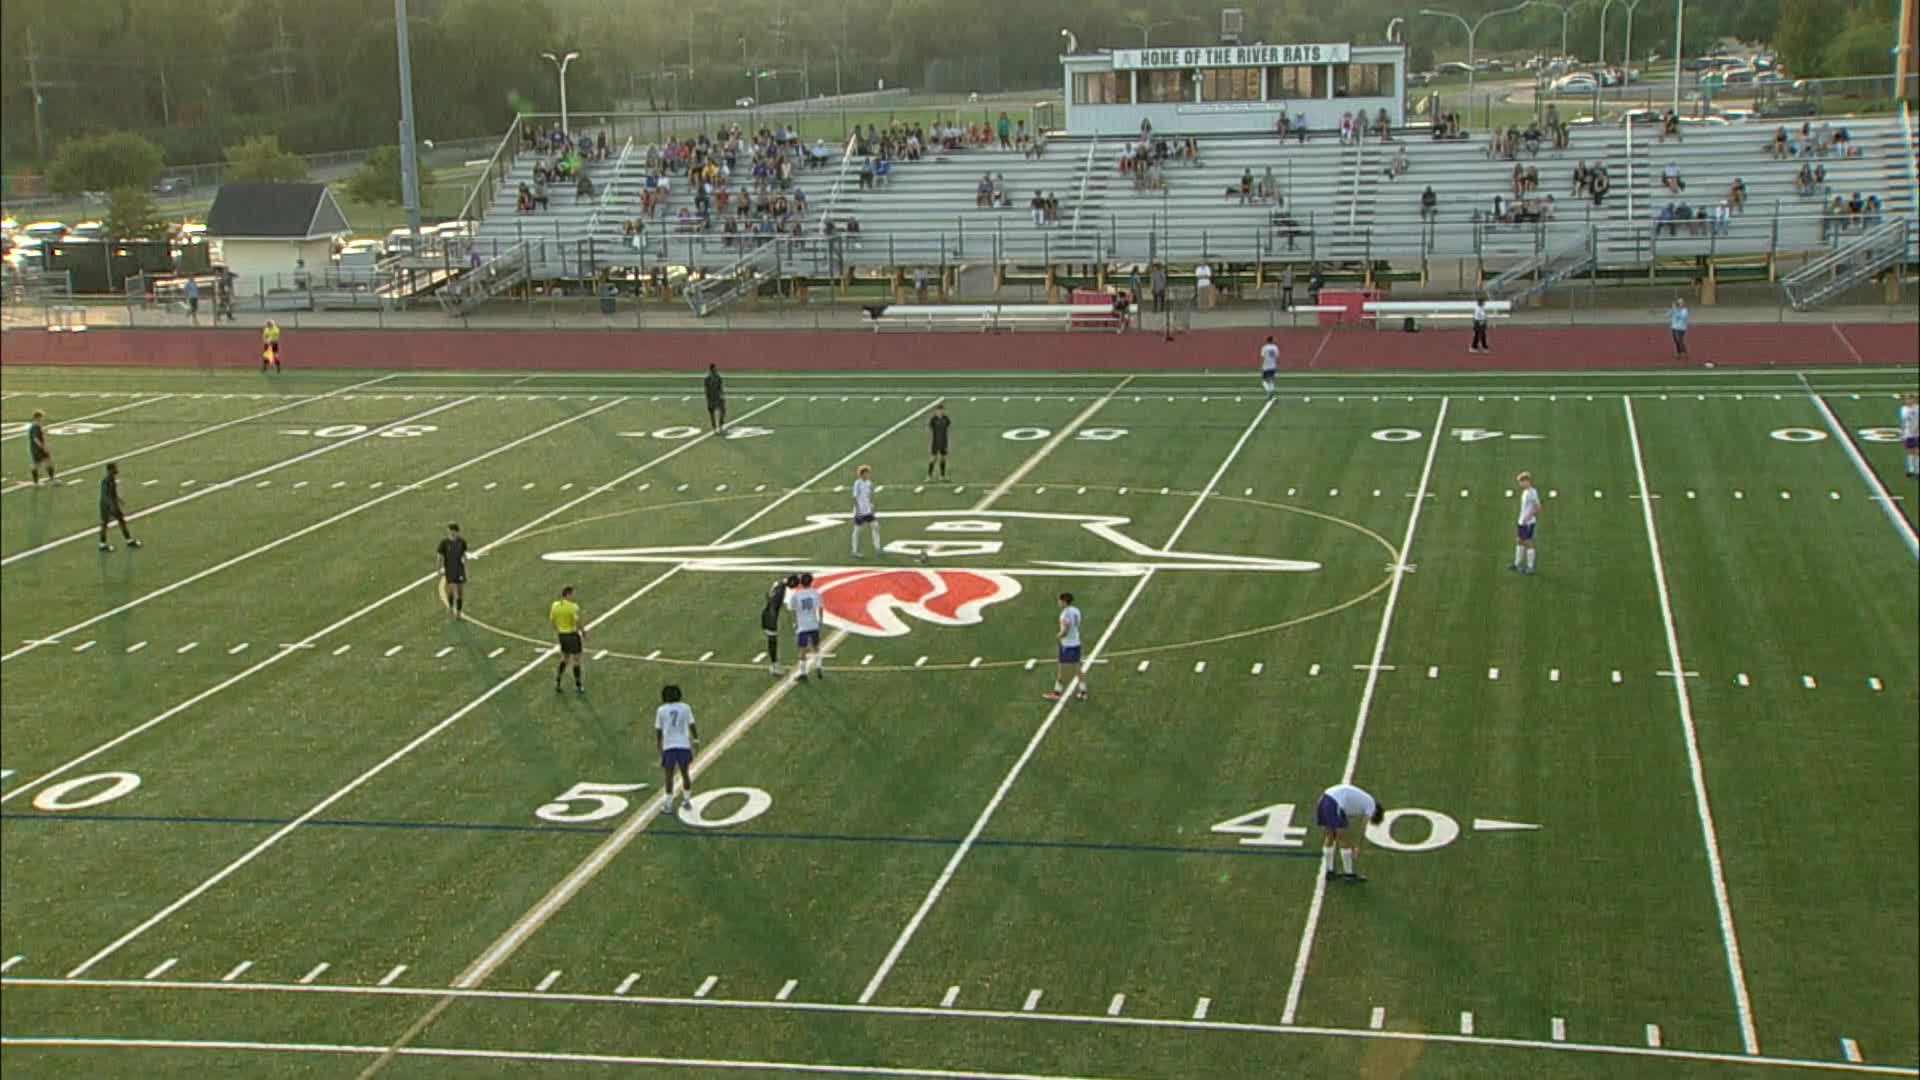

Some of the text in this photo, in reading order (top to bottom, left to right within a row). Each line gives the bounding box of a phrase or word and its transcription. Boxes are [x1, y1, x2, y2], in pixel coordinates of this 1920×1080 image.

[1141, 46, 1321, 66] HOME OF THE RIVER RATS
[669, 710, 679, 727] 7
[534, 781, 773, 827] 50
[1210, 803, 1460, 852] 40
